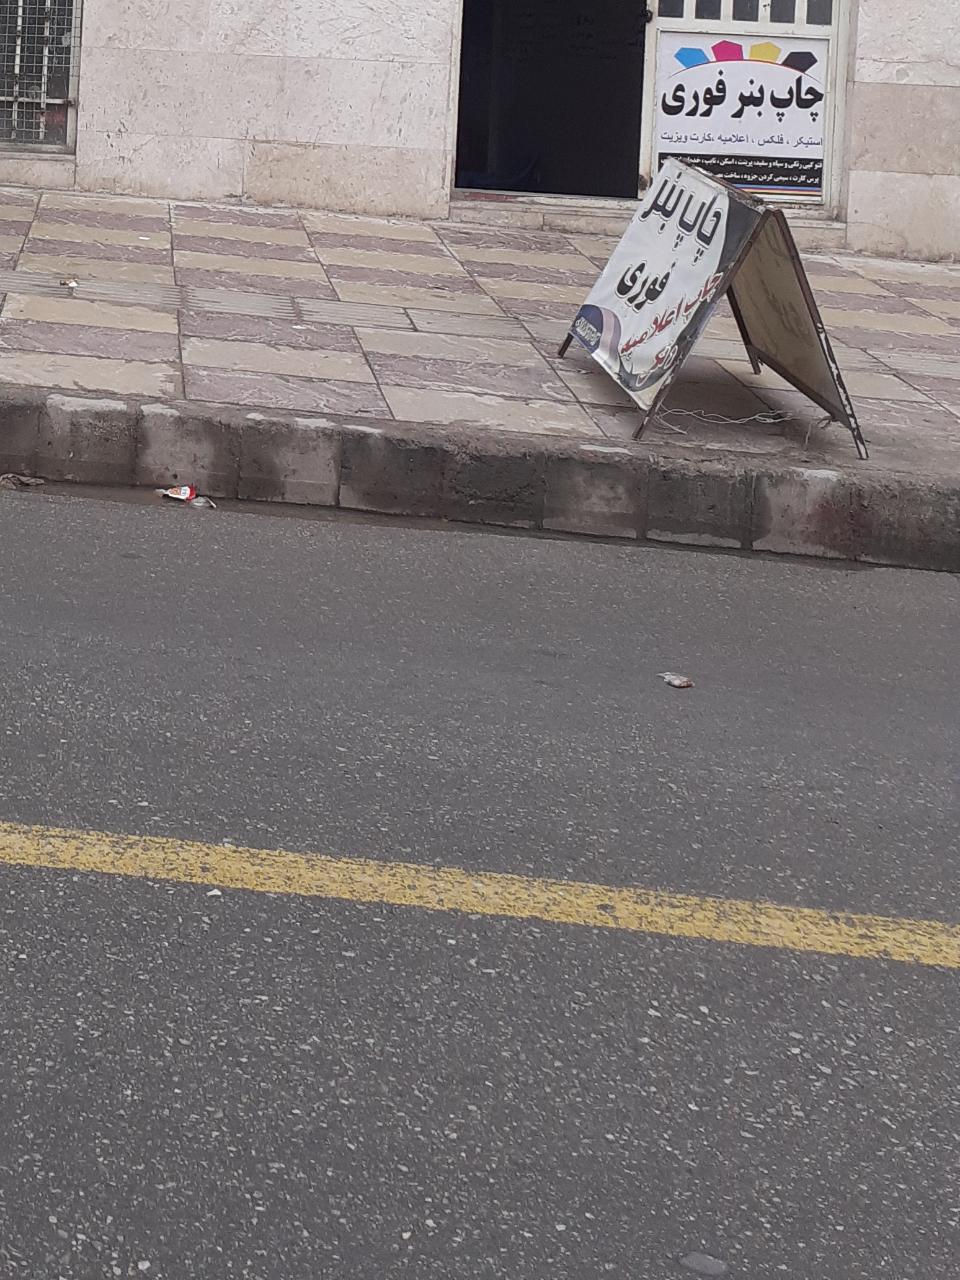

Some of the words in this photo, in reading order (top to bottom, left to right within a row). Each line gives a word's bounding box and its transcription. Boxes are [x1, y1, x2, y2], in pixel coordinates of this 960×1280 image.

[661, 70, 727, 117] فوری
[731, 78, 765, 118] بنر
[770, 75, 824, 122] چاپ
[717, 133, 748, 144] اعلامیه
[757, 133, 783, 147] فلکس
[792, 136, 823, 148] استیکر
[616, 261, 676, 311] فوری
